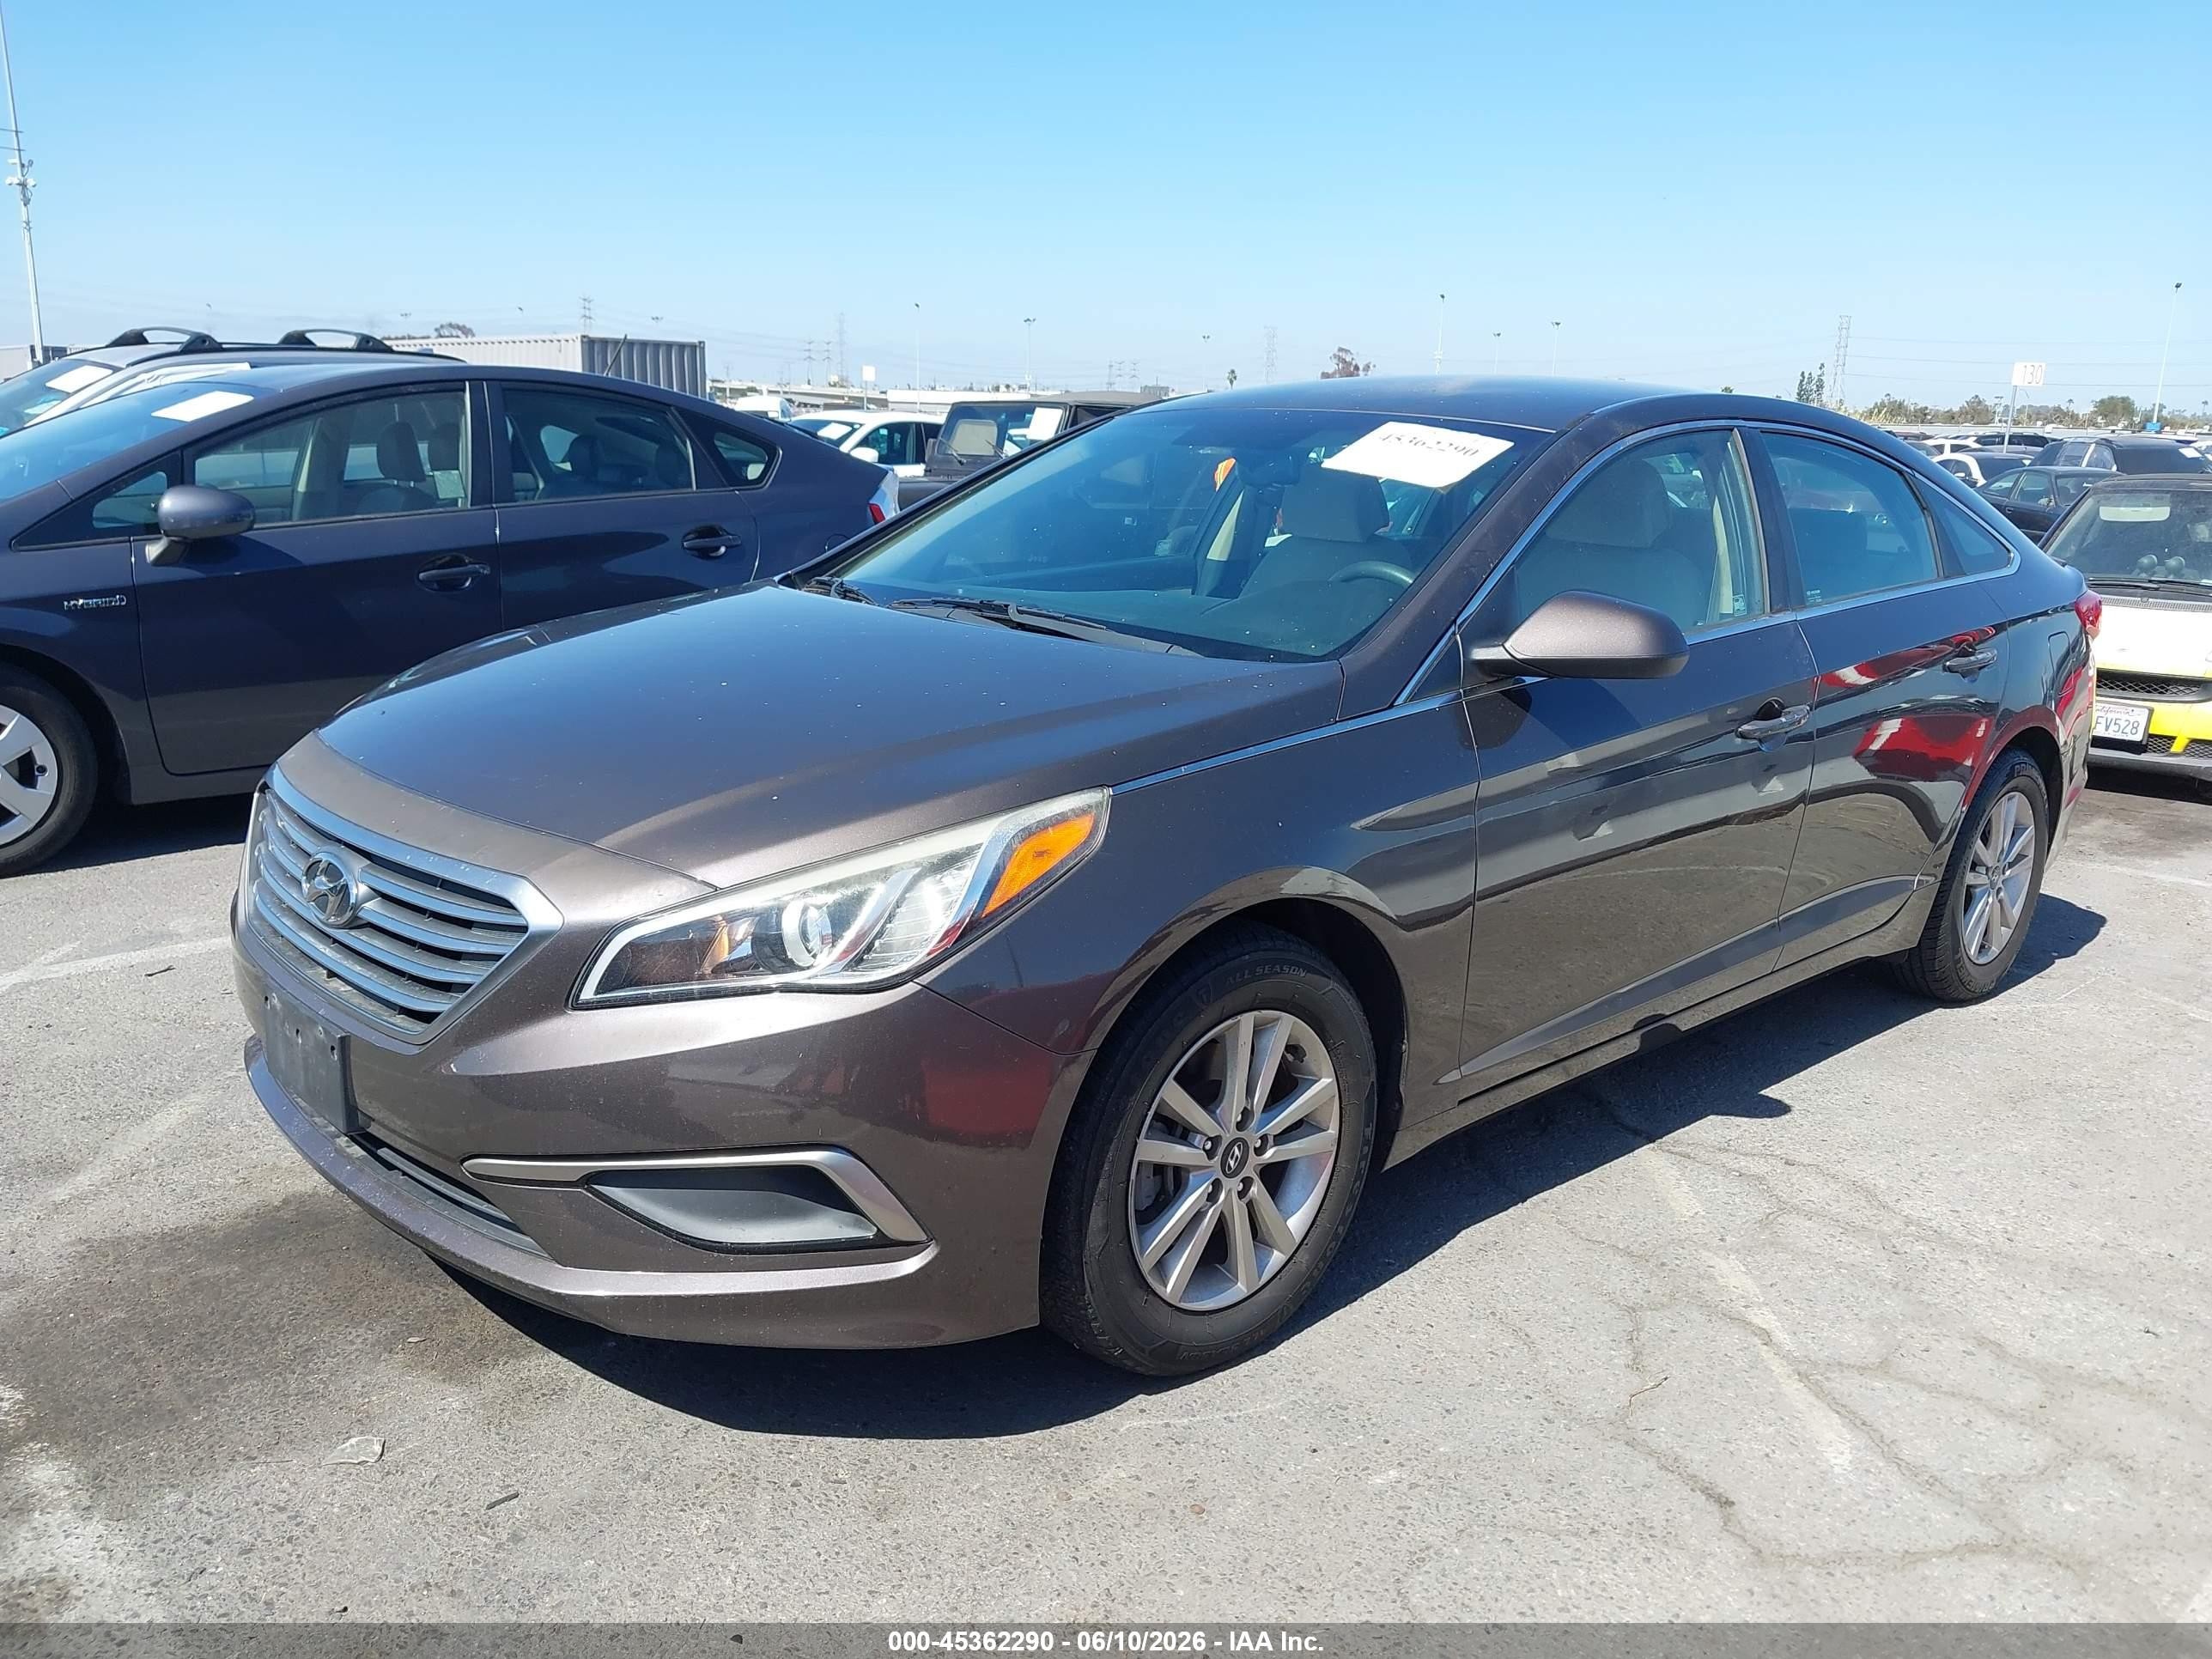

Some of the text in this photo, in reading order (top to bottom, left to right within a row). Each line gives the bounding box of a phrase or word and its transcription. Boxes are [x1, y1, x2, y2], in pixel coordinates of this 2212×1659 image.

[2023, 364, 2043, 385] 130
[64, 594, 126, 611] HYBRID
[2095, 706, 2130, 715] alifornia
[1226, 965, 1306, 984] ALL SEASON
